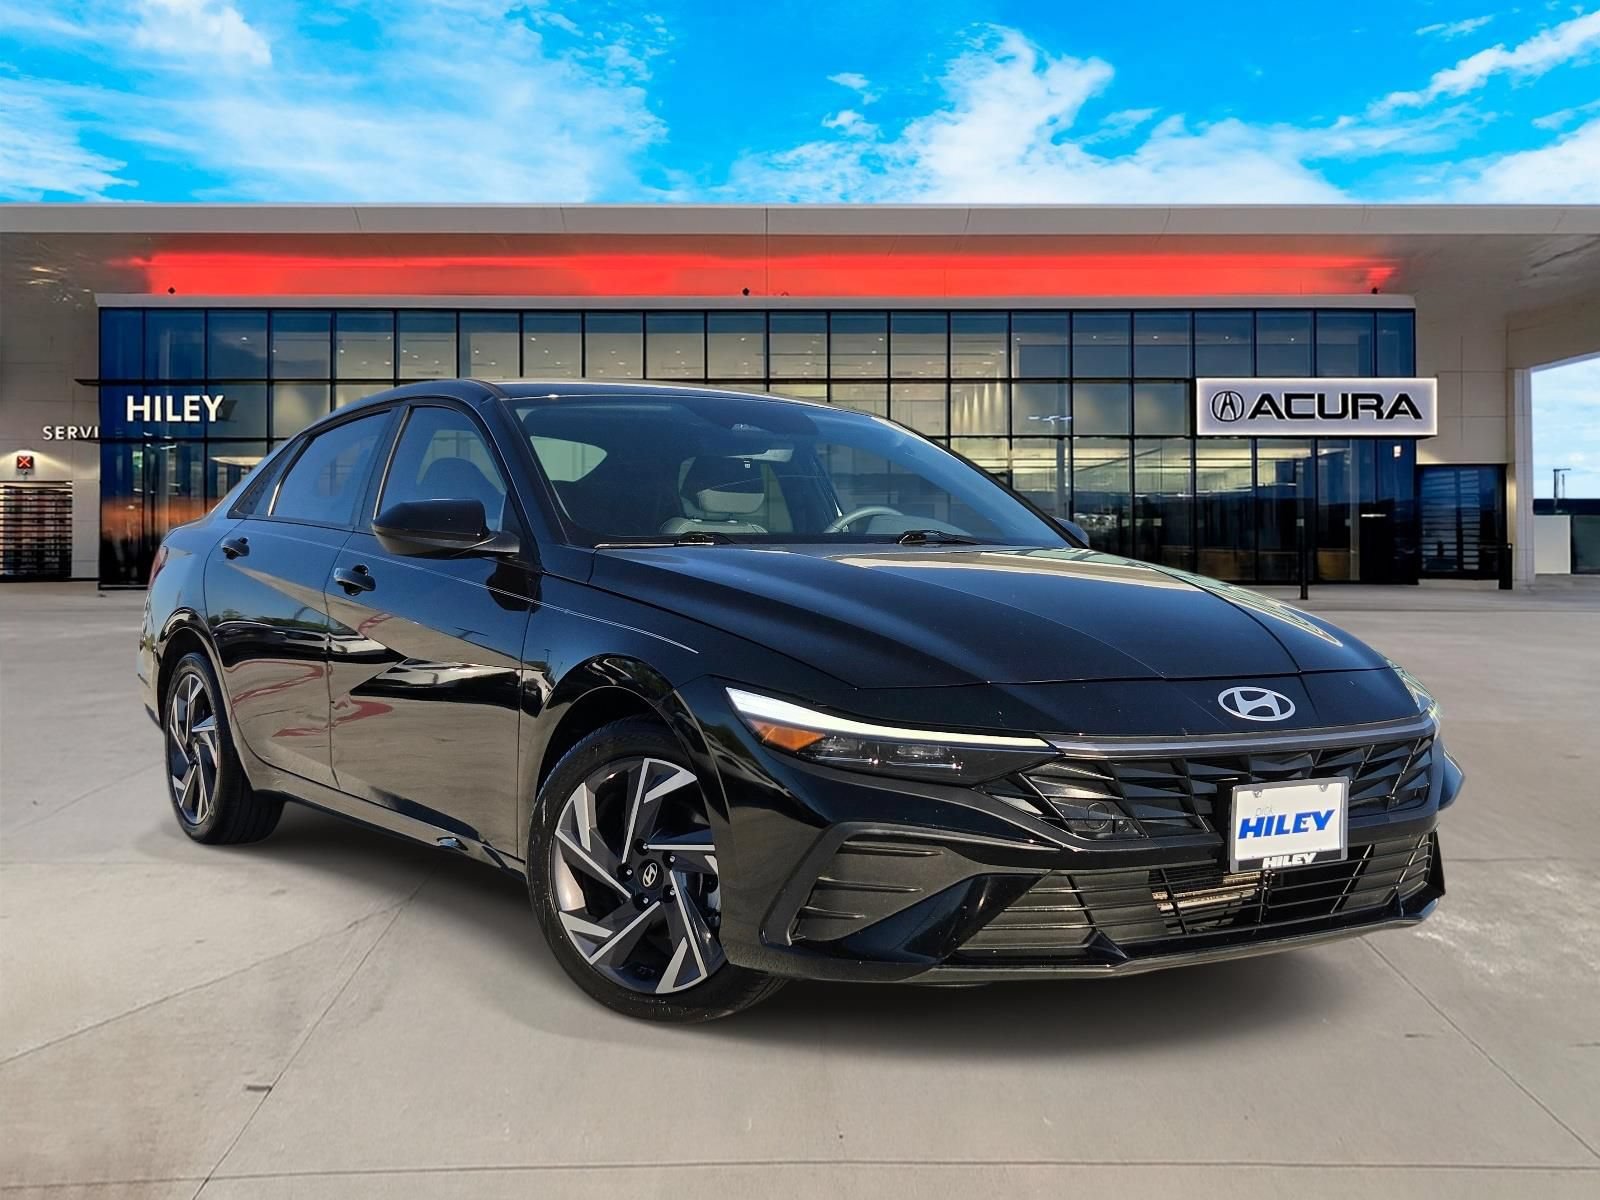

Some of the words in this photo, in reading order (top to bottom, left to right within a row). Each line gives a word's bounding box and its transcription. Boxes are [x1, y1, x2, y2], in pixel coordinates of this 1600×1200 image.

[127, 395, 224, 422] HILEY
[1248, 393, 1423, 420] ACURA
[1238, 809, 1335, 839] HILEY
[1262, 852, 1317, 869] HILEY
